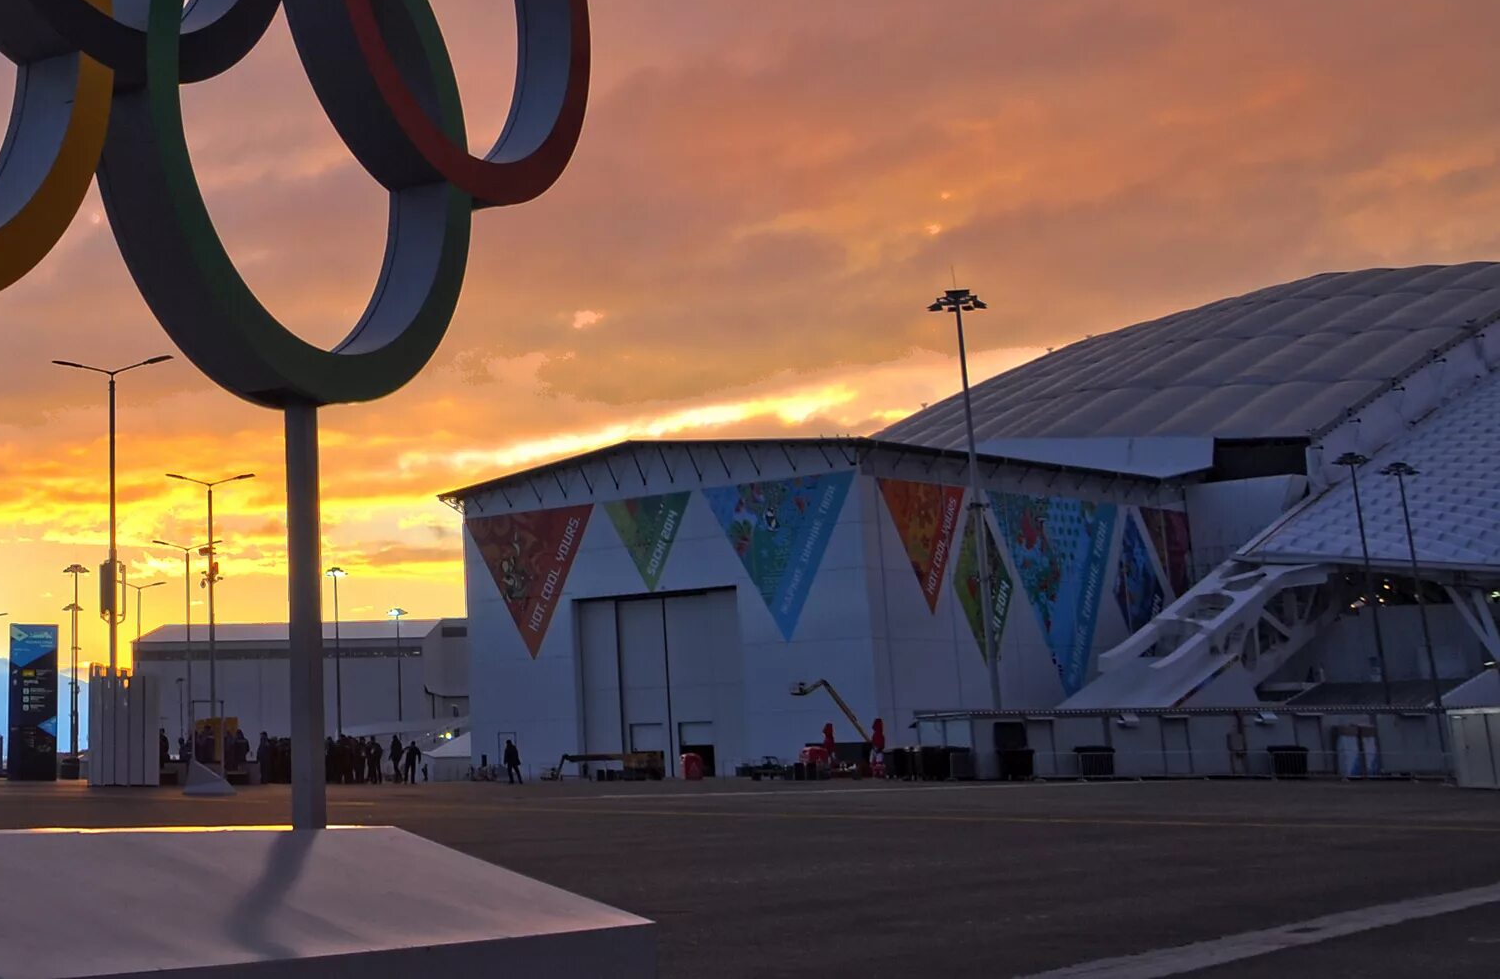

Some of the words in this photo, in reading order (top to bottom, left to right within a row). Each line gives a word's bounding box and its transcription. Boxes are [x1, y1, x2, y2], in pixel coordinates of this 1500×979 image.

[647, 539, 668, 576] SOCHI
[660, 509, 679, 540] 2014
[995, 580, 1010, 616] 2014
